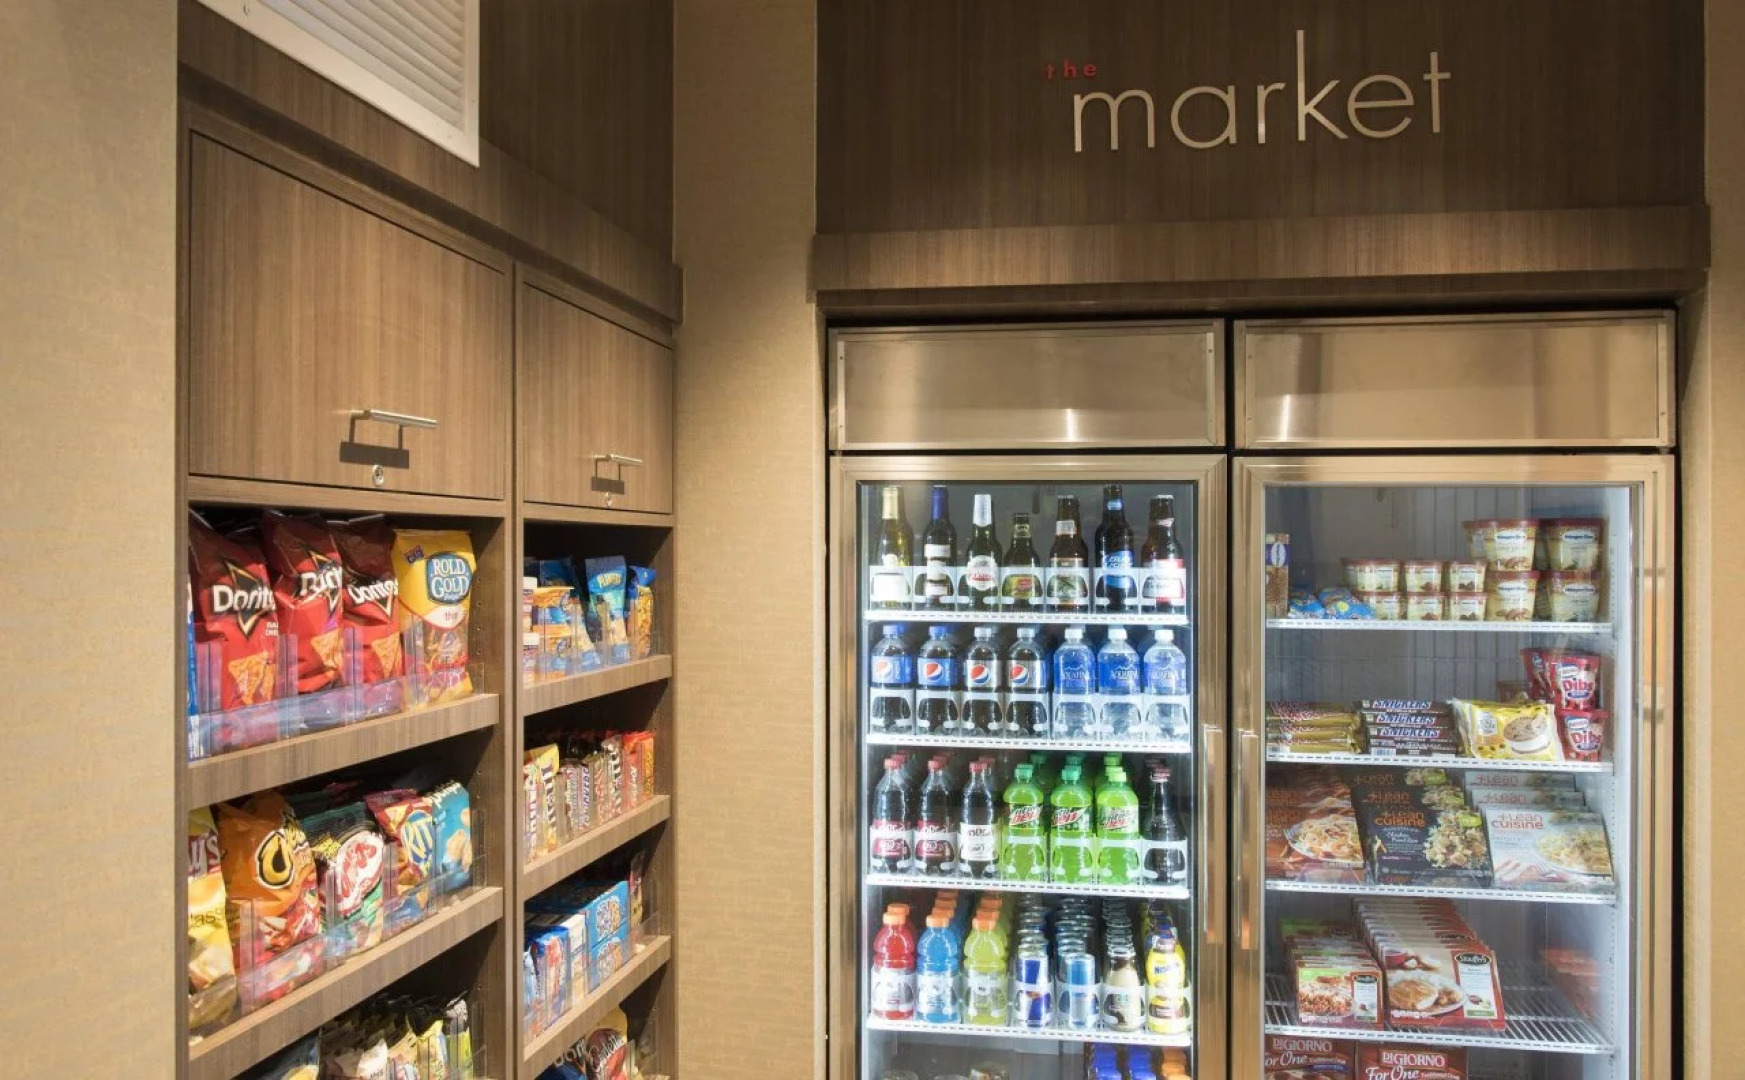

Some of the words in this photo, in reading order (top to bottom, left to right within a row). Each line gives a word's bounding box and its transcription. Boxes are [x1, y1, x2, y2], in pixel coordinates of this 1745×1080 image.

[1044, 59, 1097, 79] the
[1074, 29, 1451, 152] market
[431, 558, 466, 577] ROLD
[431, 577, 469, 599] GOLD
[1562, 678, 1594, 692] Dibs
[1372, 700, 1432, 710] SNICKERS
[1376, 714, 1437, 724] SNICKERS
[1380, 727, 1440, 738] SNICKERS
[1571, 730, 1603, 744] Dibs
[1374, 817, 1428, 827] cuisine
[1490, 820, 1545, 829] cuisine
[1280, 1050, 1308, 1066] One
[1382, 1052, 1446, 1067] DIGIORNO
[1365, 1066, 1389, 1080] For
[1390, 1064, 1419, 1080] One
